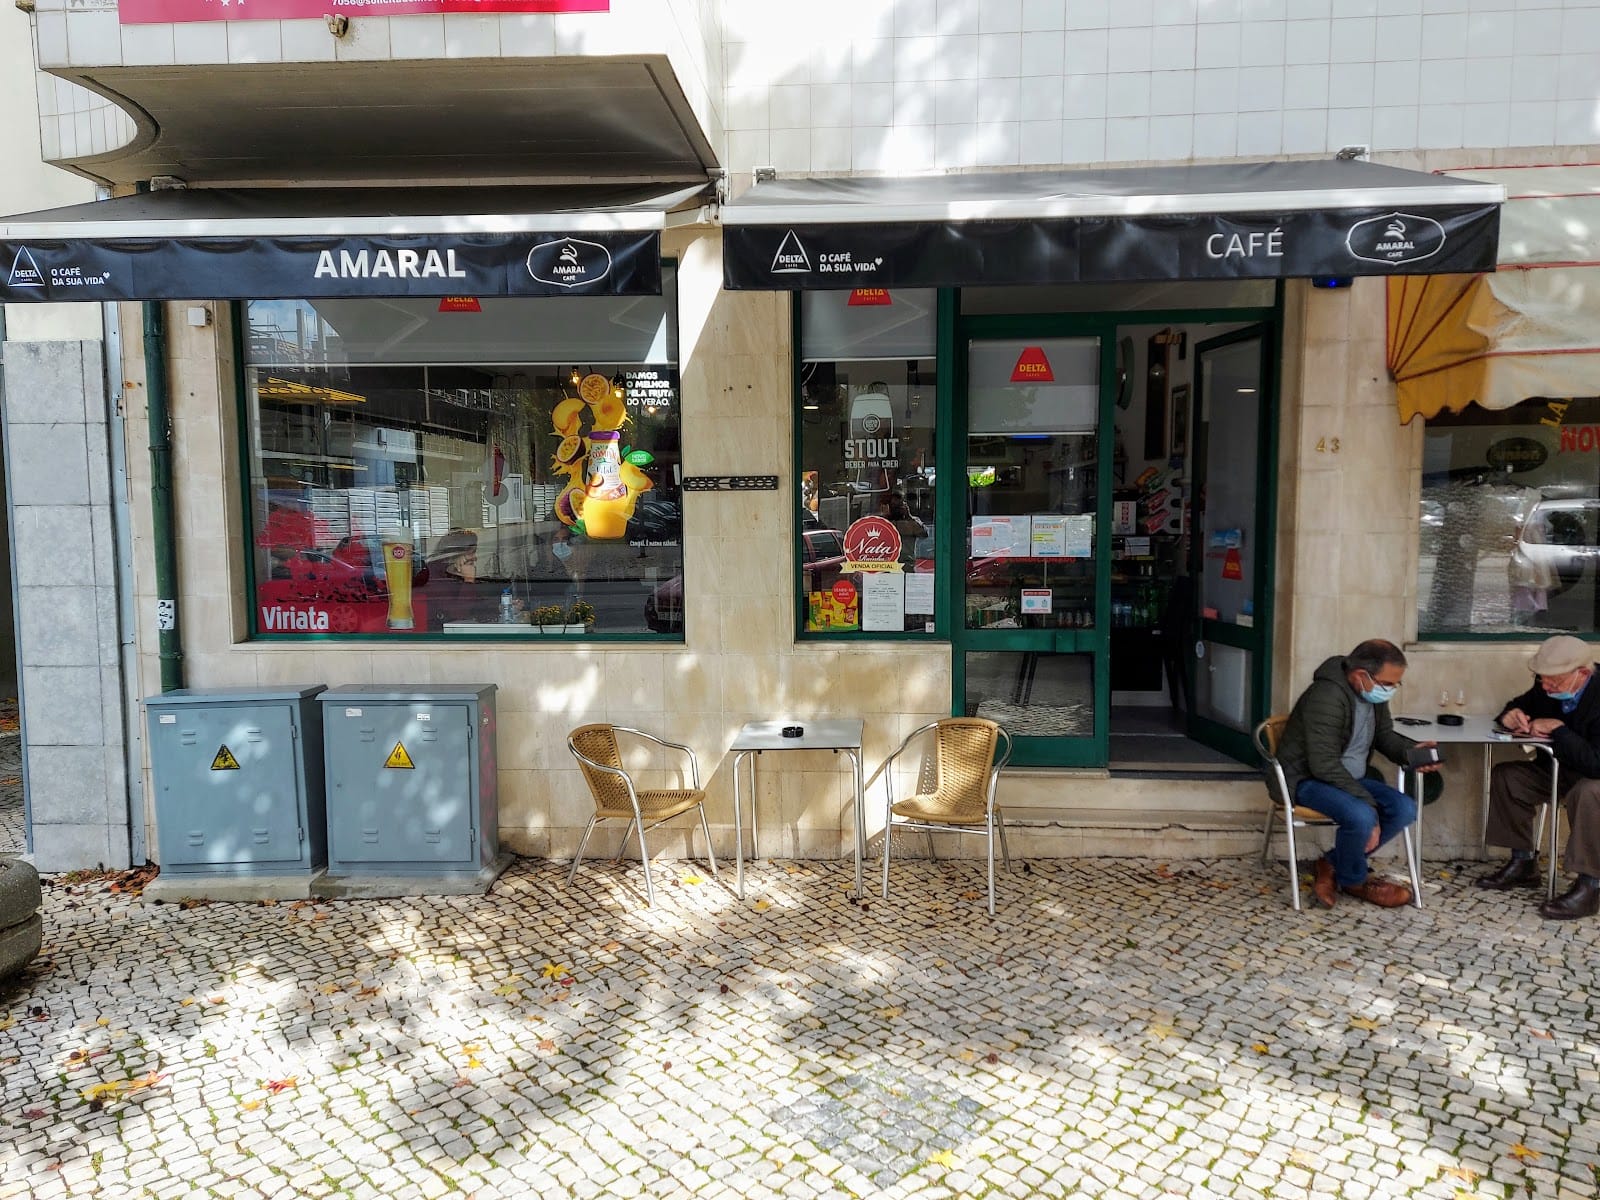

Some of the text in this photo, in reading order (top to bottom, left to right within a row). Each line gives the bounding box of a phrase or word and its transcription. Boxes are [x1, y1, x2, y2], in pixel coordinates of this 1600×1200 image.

[1207, 228, 1284, 258] CAFÉ
[1375, 241, 1415, 251] AMARAL
[779, 254, 804, 264] DELTA
[820, 252, 851, 262] O CAFÉ
[313, 249, 467, 279] AMARAL
[820, 262, 876, 272] DA SUA VIDA
[15, 269, 38, 278] DELTA
[59, 267, 81, 276] CAFÉ
[552, 265, 586, 274] AMARAL
[52, 276, 105, 286] DA SUA VIDA
[1019, 363, 1047, 372] DELTA
[626, 371, 658, 380] DAMOS
[634, 380, 670, 389] MELHOR
[626, 389, 674, 398] PELA FRUTA
[626, 398, 639, 406] DO
[844, 438, 899, 459] STOUT
[844, 460, 866, 469] BEBER
[881, 460, 899, 469] CRER
[848, 536, 898, 556] Nata
[262, 606, 329, 630] Viriata
